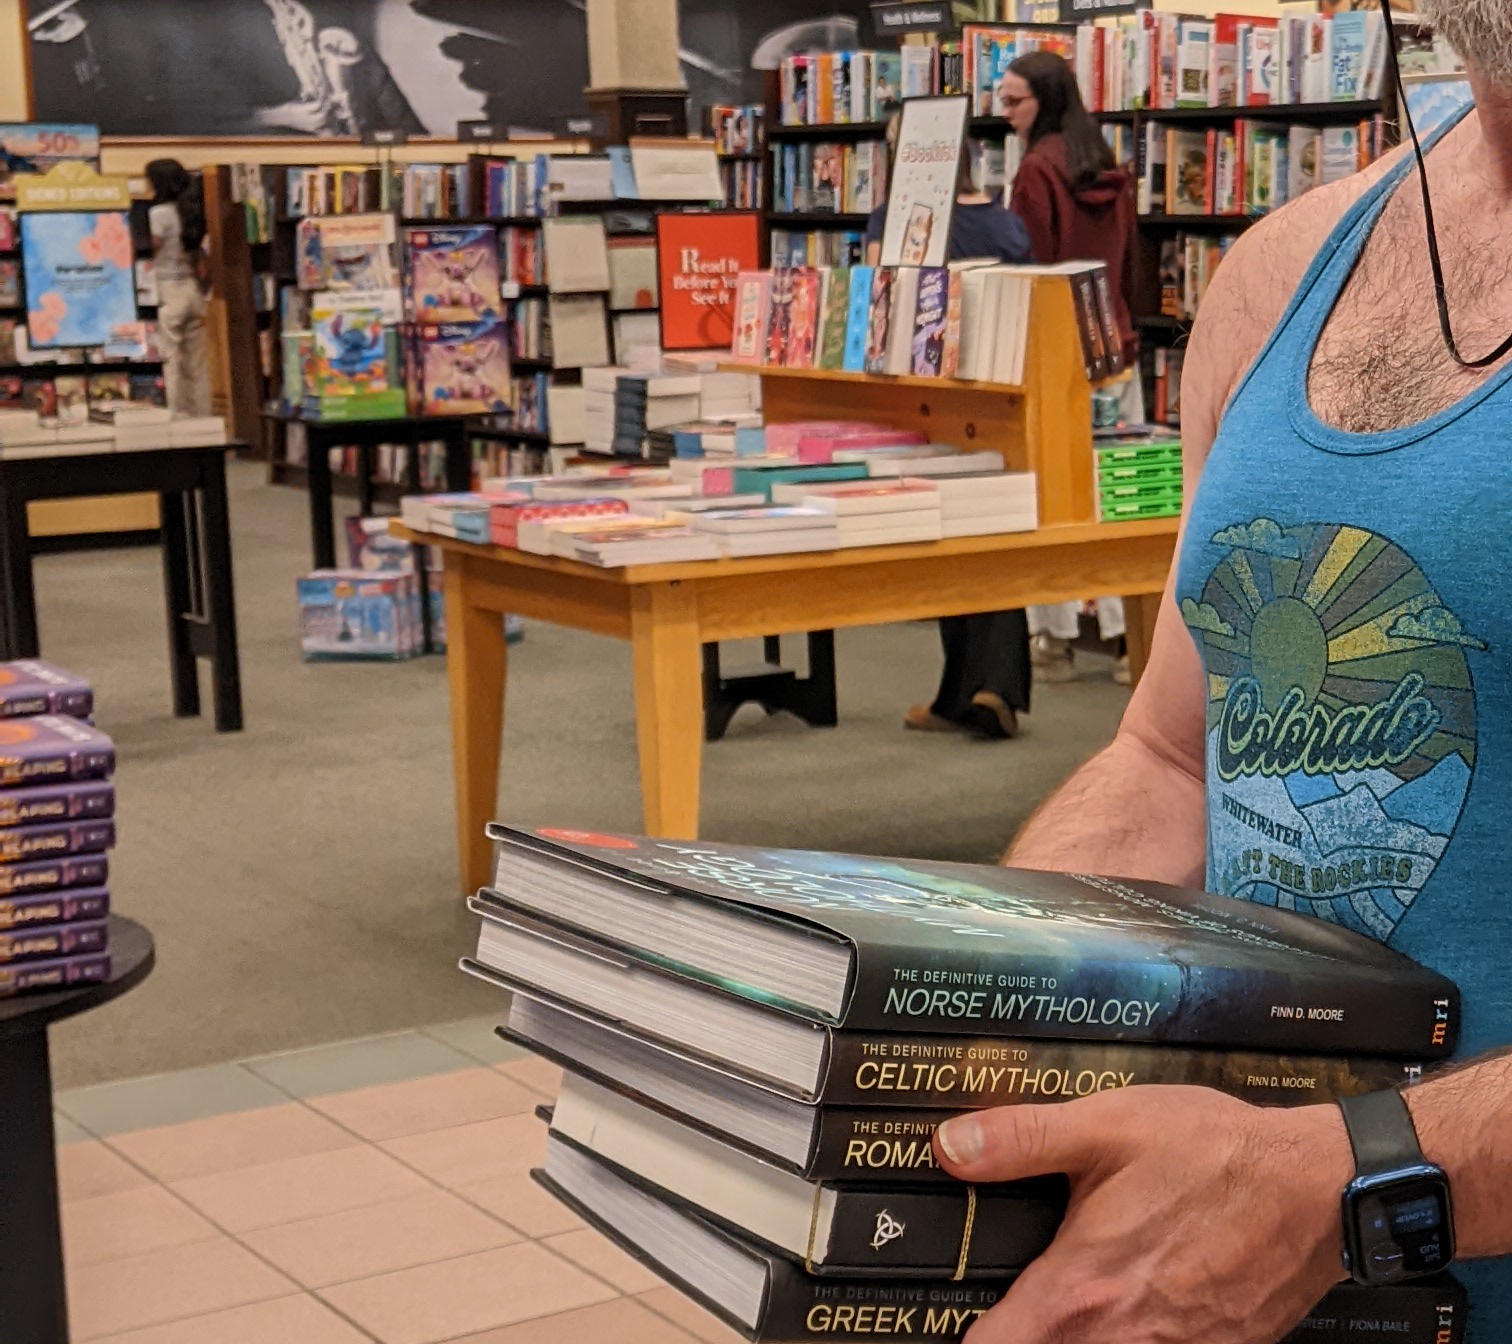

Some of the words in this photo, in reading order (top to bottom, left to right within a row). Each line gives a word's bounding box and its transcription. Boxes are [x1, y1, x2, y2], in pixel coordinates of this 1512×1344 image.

[673, 275, 718, 290] Before
[1216, 670, 1443, 782] Colorado
[1221, 792, 1304, 850] WHITEWATER
[1268, 853, 1306, 891] THE
[1310, 855, 1413, 894] ROCKIES
[893, 968, 918, 982] THE
[923, 970, 994, 986] DEFINITIVE
[997, 973, 1037, 989] GUIDE
[1041, 977, 1058, 990] TO
[883, 987, 988, 1018] NORSE
[990, 992, 1160, 1027] MYTHOLOGY
[1270, 1006, 1294, 1019] FINN
[1307, 1008, 1344, 1022] MOORE
[1431, 998, 1449, 1046] mri
[862, 1043, 888, 1056] THE
[892, 1044, 963, 1059] DEFINITIVE
[967, 1046, 1006, 1061] GUIDE
[1012, 1048, 1028, 1062] TO
[855, 1061, 958, 1092] CELTIC
[961, 1066, 1135, 1097] MYTHOLOGY
[1246, 1075, 1270, 1088] FINN
[1281, 1075, 1316, 1089] MOORE
[852, 1121, 879, 1135] THE
[844, 1139, 942, 1169] ROMA
[813, 1286, 842, 1299] THE
[846, 1287, 925, 1302] DEFINITIVE
[929, 1288, 972, 1304] GUIDE
[806, 1304, 915, 1334] GREEK
